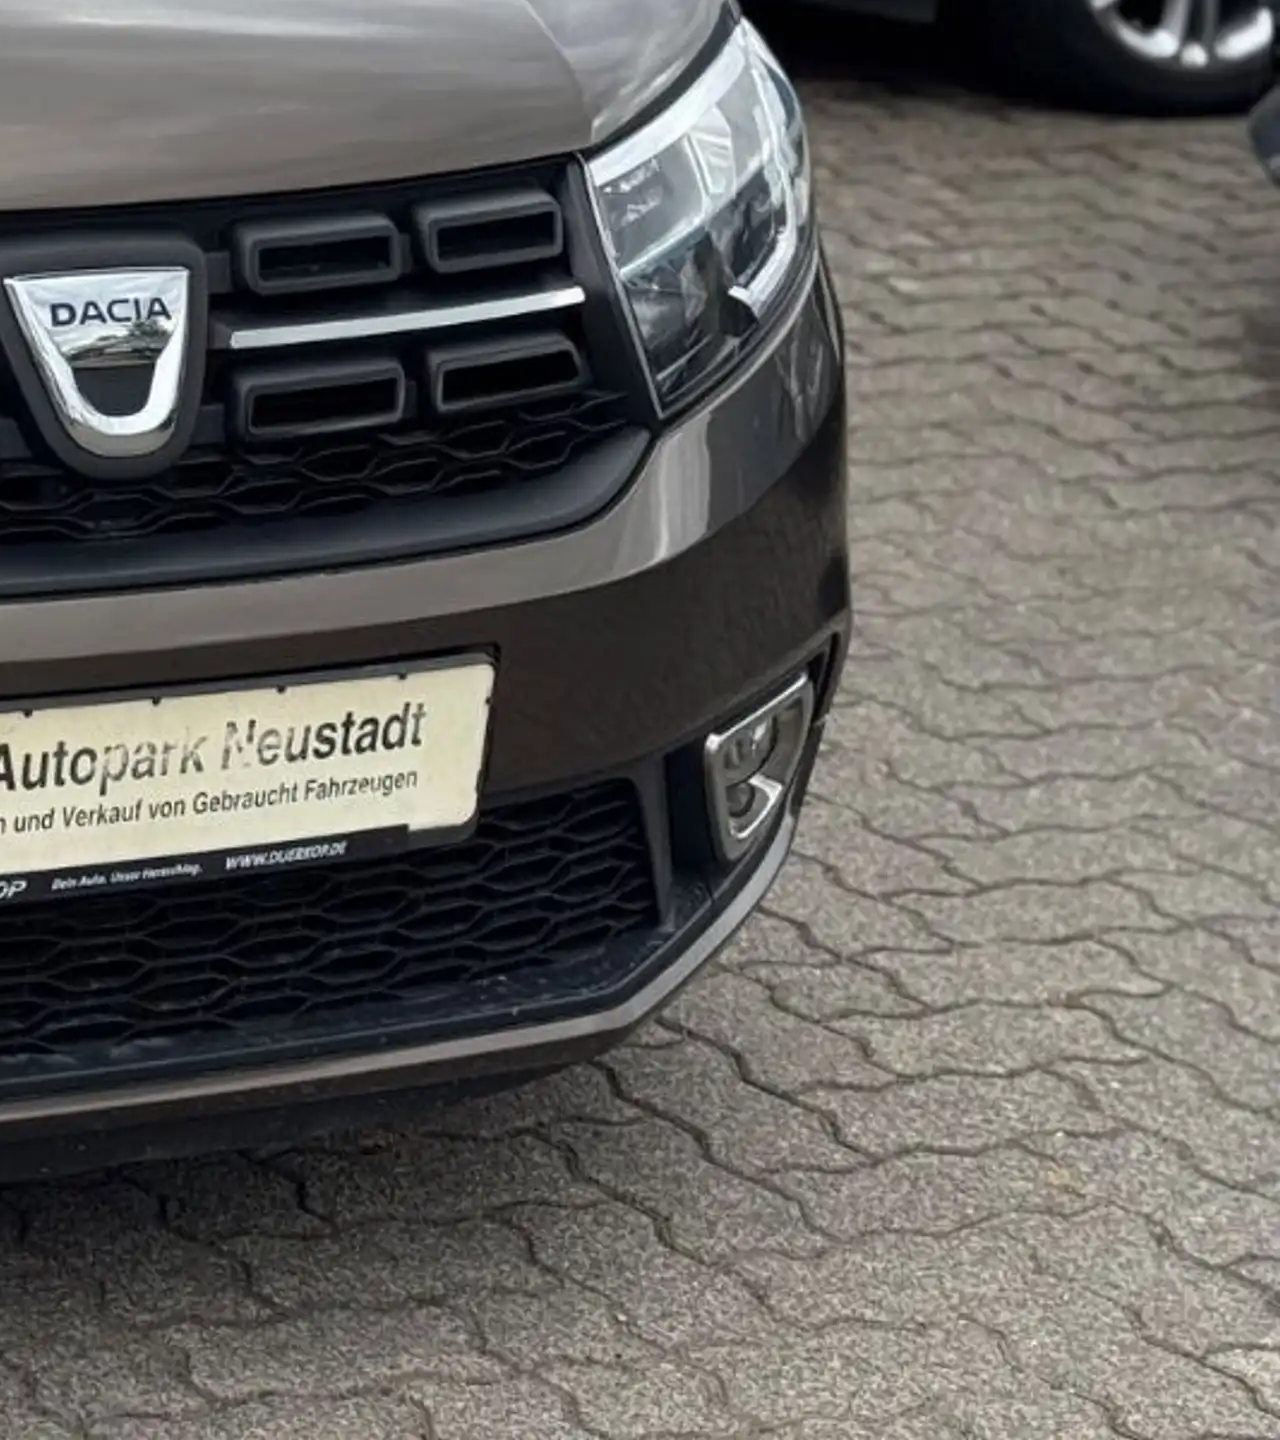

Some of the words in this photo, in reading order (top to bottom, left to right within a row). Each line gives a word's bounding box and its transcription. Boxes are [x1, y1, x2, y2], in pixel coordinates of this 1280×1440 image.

[50, 296, 172, 327] DACIA
[220, 701, 427, 770] Neustadt
[13, 808, 55, 833] und
[63, 798, 143, 828] Verkauf
[148, 799, 186, 820] von
[193, 782, 297, 815] Gebraucht
[303, 770, 417, 801] Fahrzeugen
